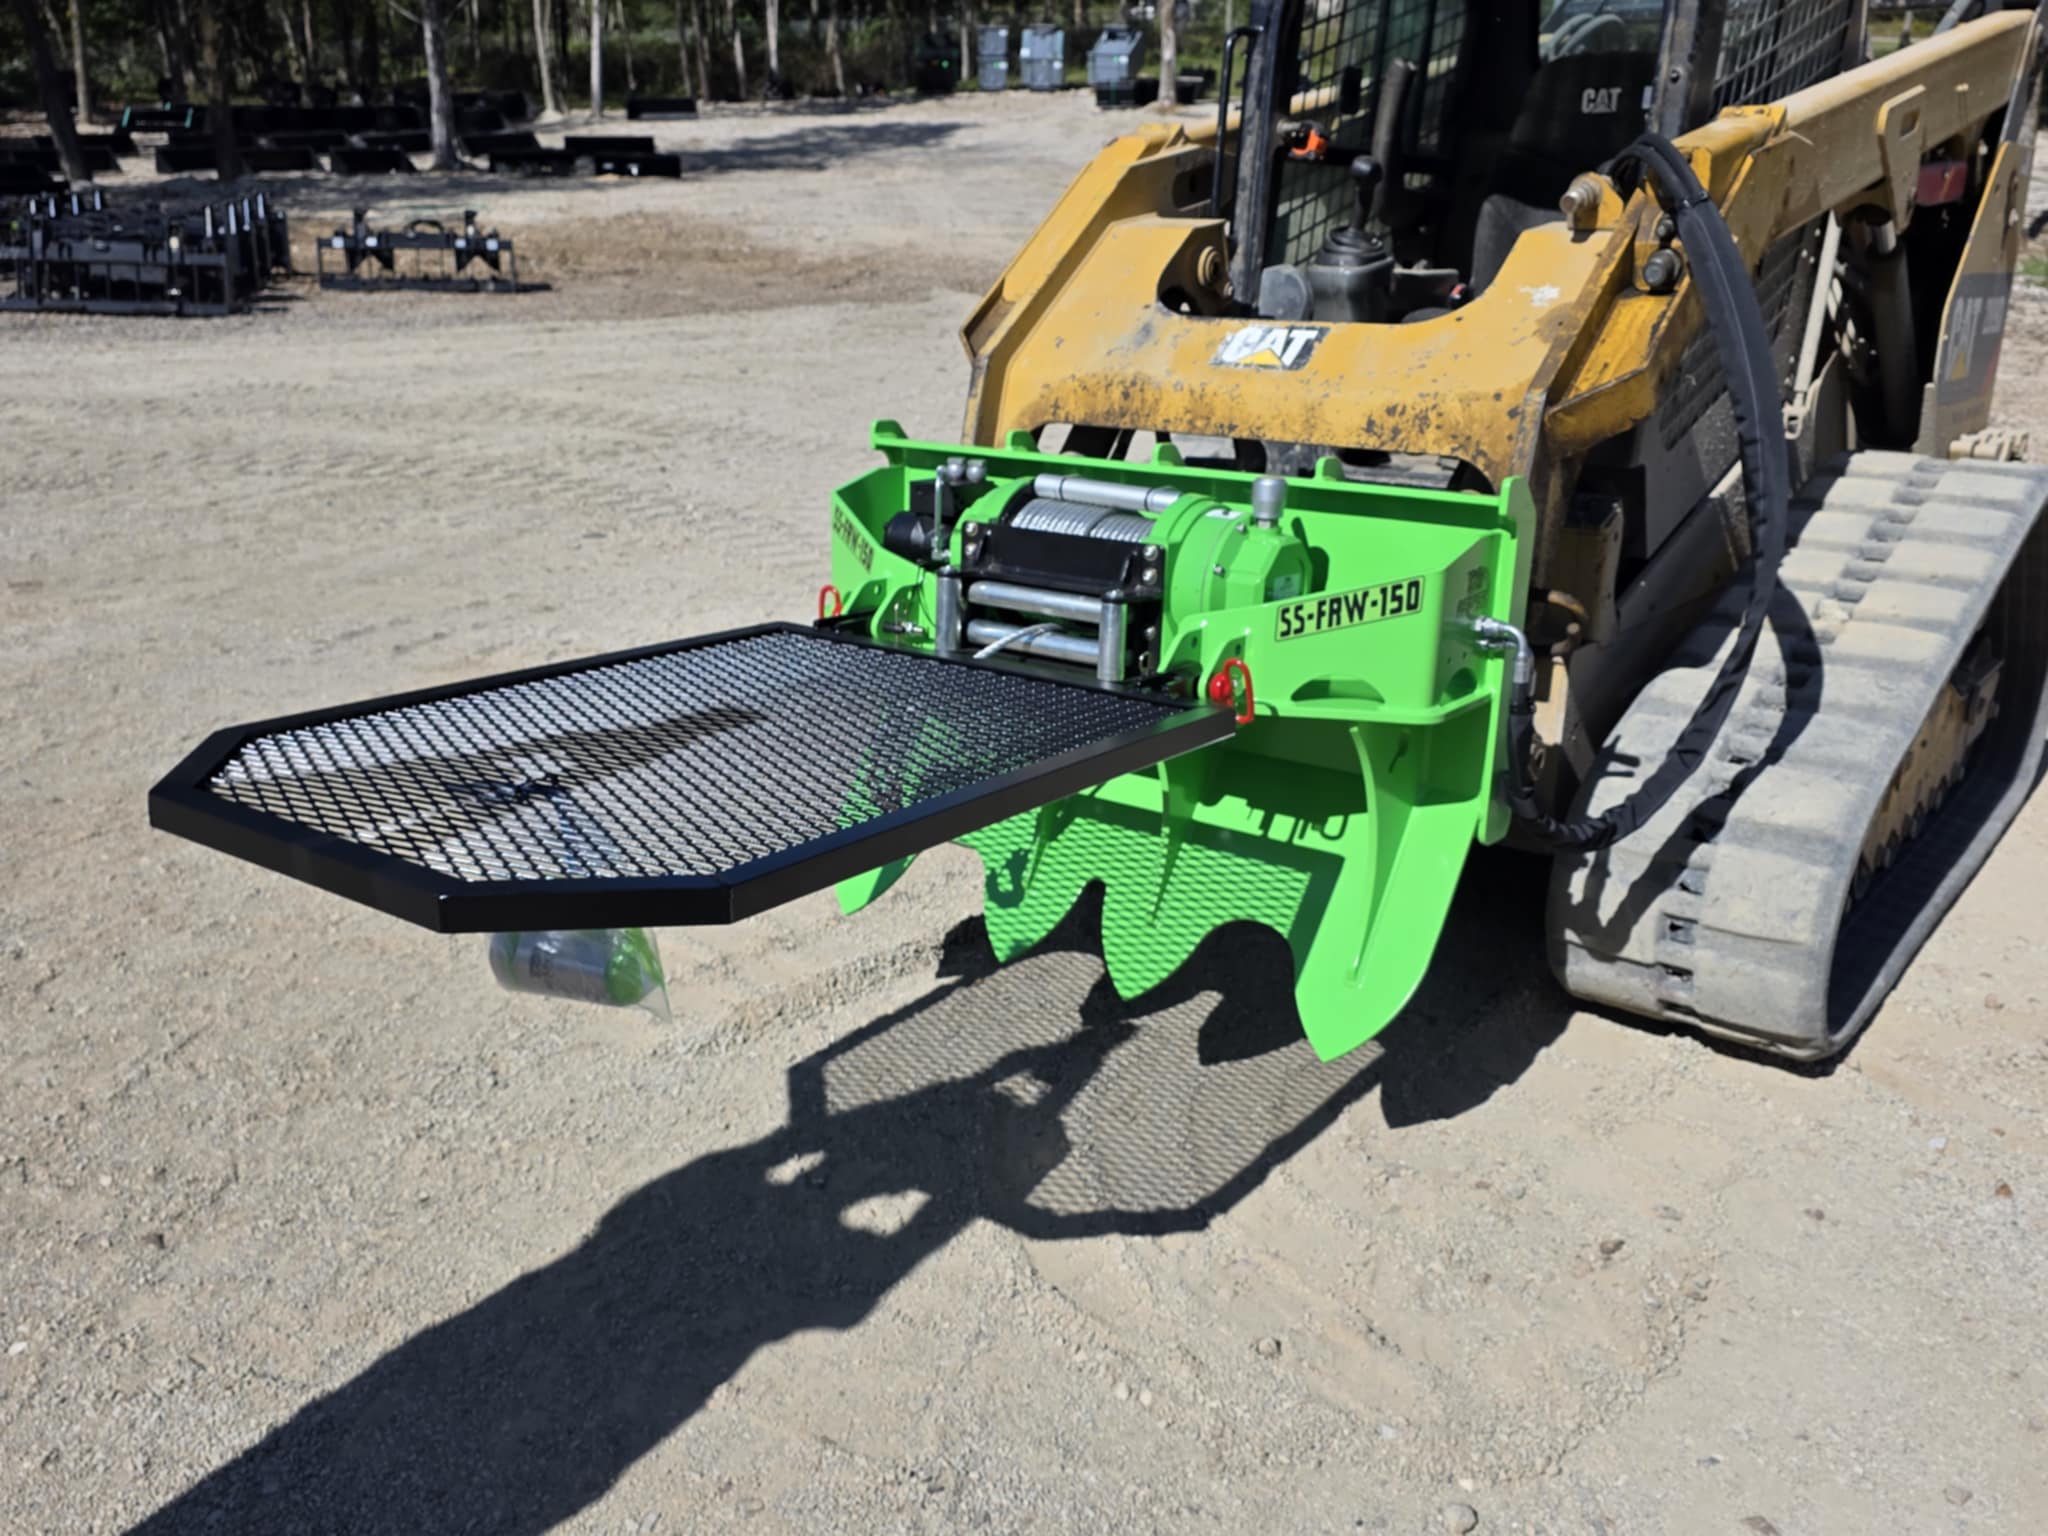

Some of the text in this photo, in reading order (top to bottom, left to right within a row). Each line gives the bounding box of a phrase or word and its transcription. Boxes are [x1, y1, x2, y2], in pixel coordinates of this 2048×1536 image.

[1581, 87, 1622, 114] CAT
[1220, 325, 1320, 367] CAT
[1944, 296, 1983, 382] CAT
[1279, 579, 1420, 638] SS-FRW-150
